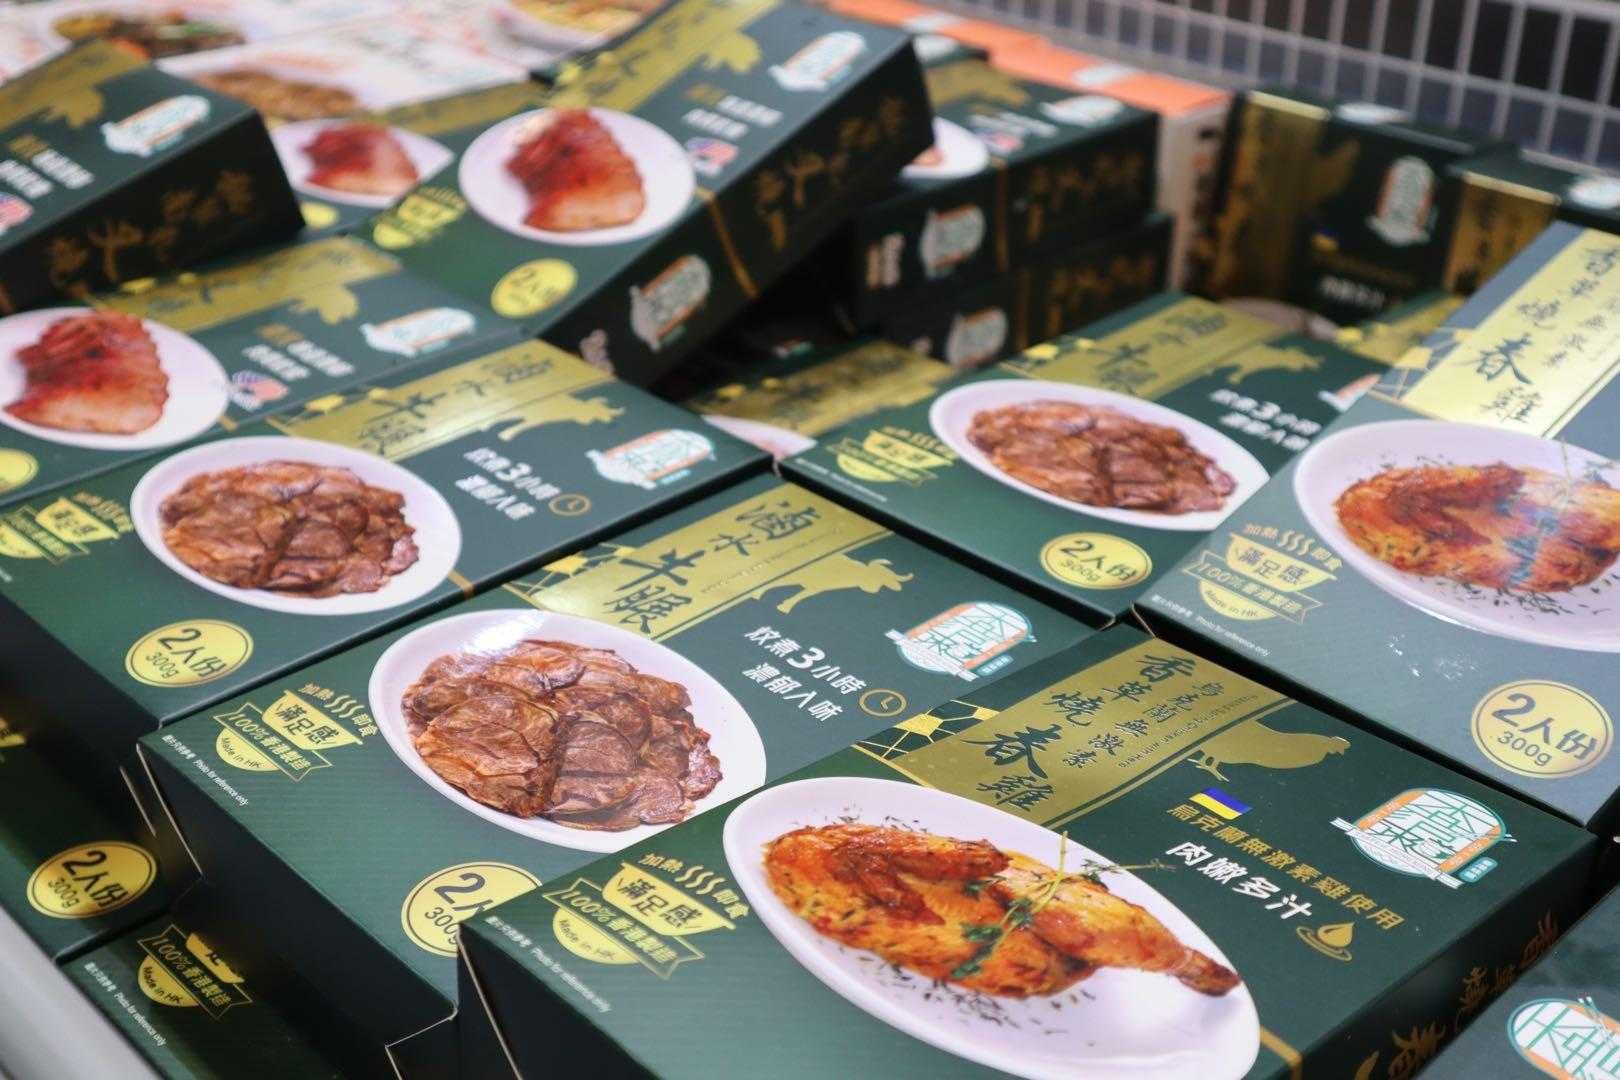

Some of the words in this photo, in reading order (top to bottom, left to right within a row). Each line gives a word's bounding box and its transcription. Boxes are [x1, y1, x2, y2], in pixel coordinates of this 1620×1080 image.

[1060, 540, 1137, 581] 2人份
[145, 652, 179, 679] 300g
[158, 628, 227, 678] 2人份
[744, 626, 867, 695] 炆煮3小時
[742, 662, 843, 721] 濃郁入味
[228, 713, 312, 772] 100%香港製造
[275, 704, 339, 745] 滿足感
[1492, 692, 1599, 761] 2人份
[1497, 731, 1553, 767] 300g
[62, 850, 129, 908] 2人份
[638, 853, 684, 874] 加熱
[1166, 841, 1313, 920] 肉嫩多汁
[1167, 804, 1405, 930] 烏克蘭無激素雞使用
[48, 877, 80, 909] 300g
[617, 878, 702, 928] 滿足感
